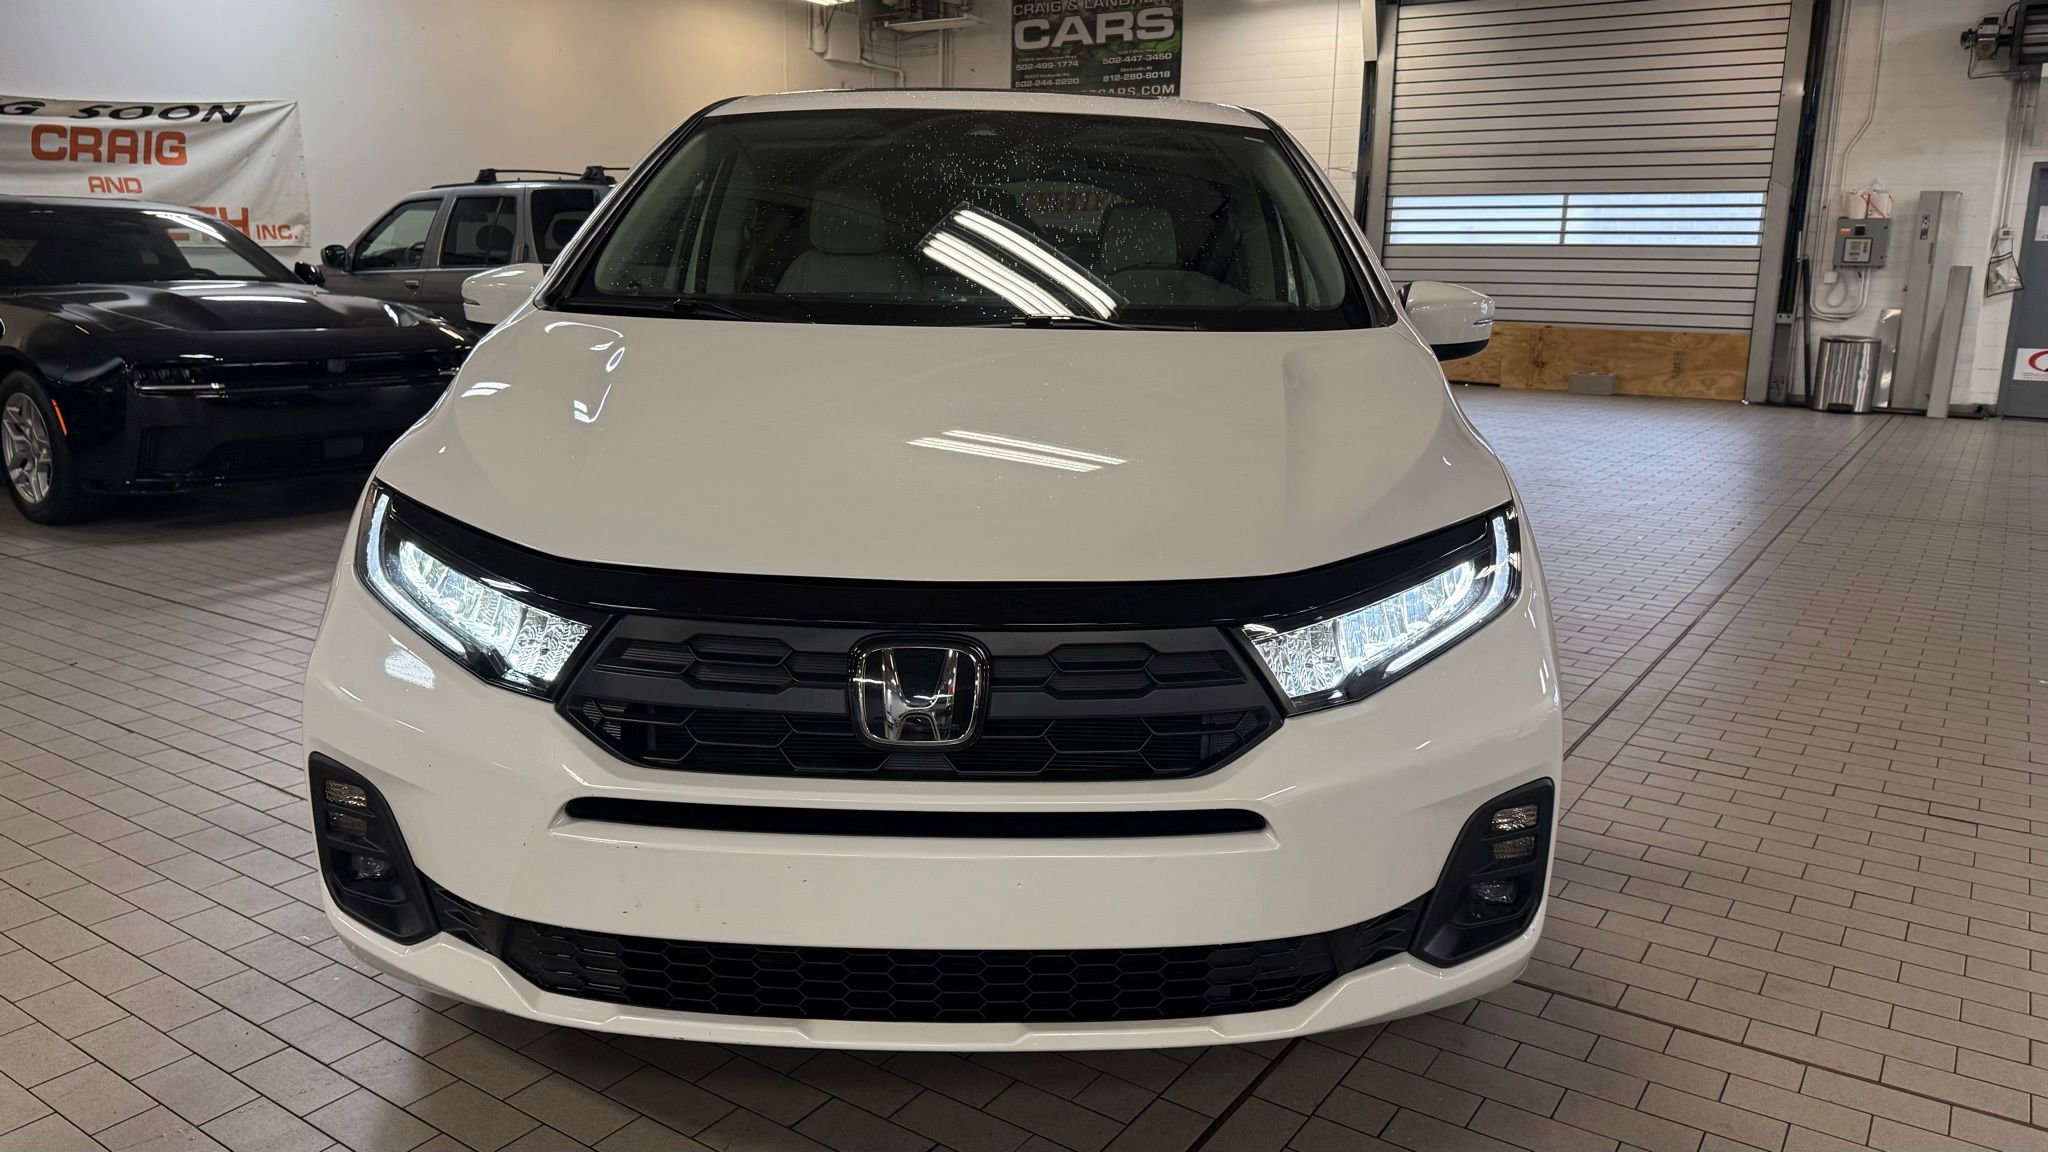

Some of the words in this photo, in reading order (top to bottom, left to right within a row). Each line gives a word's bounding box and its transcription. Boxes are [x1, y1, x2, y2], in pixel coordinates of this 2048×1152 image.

[1013, 1, 1062, 16] CRAIG
[1067, 0, 1081, 11] &
[1014, 7, 1175, 50] CARS
[1015, 60, 1079, 71] 502-499-1774
[1102, 53, 1172, 65] 502-447-3450
[1015, 78, 1080, 88] 502-244-2220
[1102, 70, 1171, 82] 812-280-8018
[68, 104, 246, 123] SOON
[31, 124, 188, 166] CRAIG
[87, 176, 143, 194] AND
[256, 224, 299, 240] INC.
